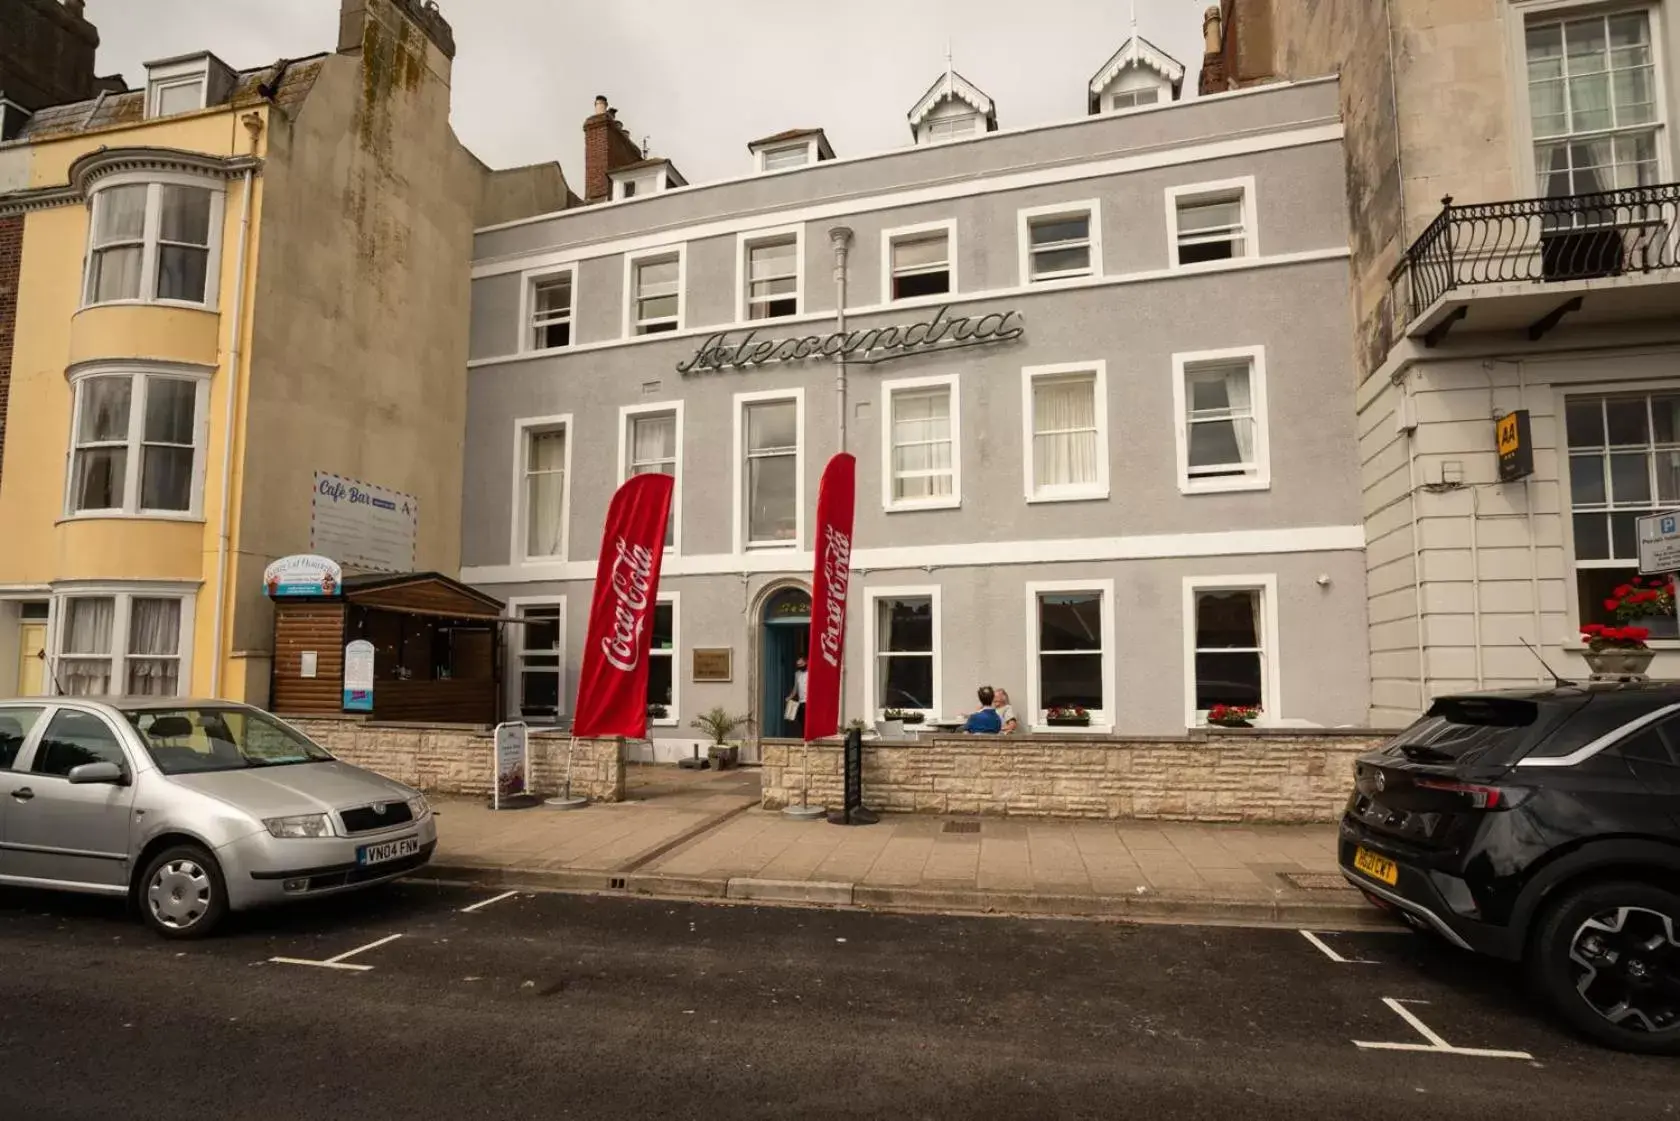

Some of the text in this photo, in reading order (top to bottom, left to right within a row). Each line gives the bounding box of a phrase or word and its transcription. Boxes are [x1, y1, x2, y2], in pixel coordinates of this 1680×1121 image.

[676, 305, 1024, 373] Alexandra
[1501, 423, 1516, 447] AA
[320, 480, 346, 502] Café
[348, 487, 370, 505] Bar
[368, 843, 397, 861] VN04
